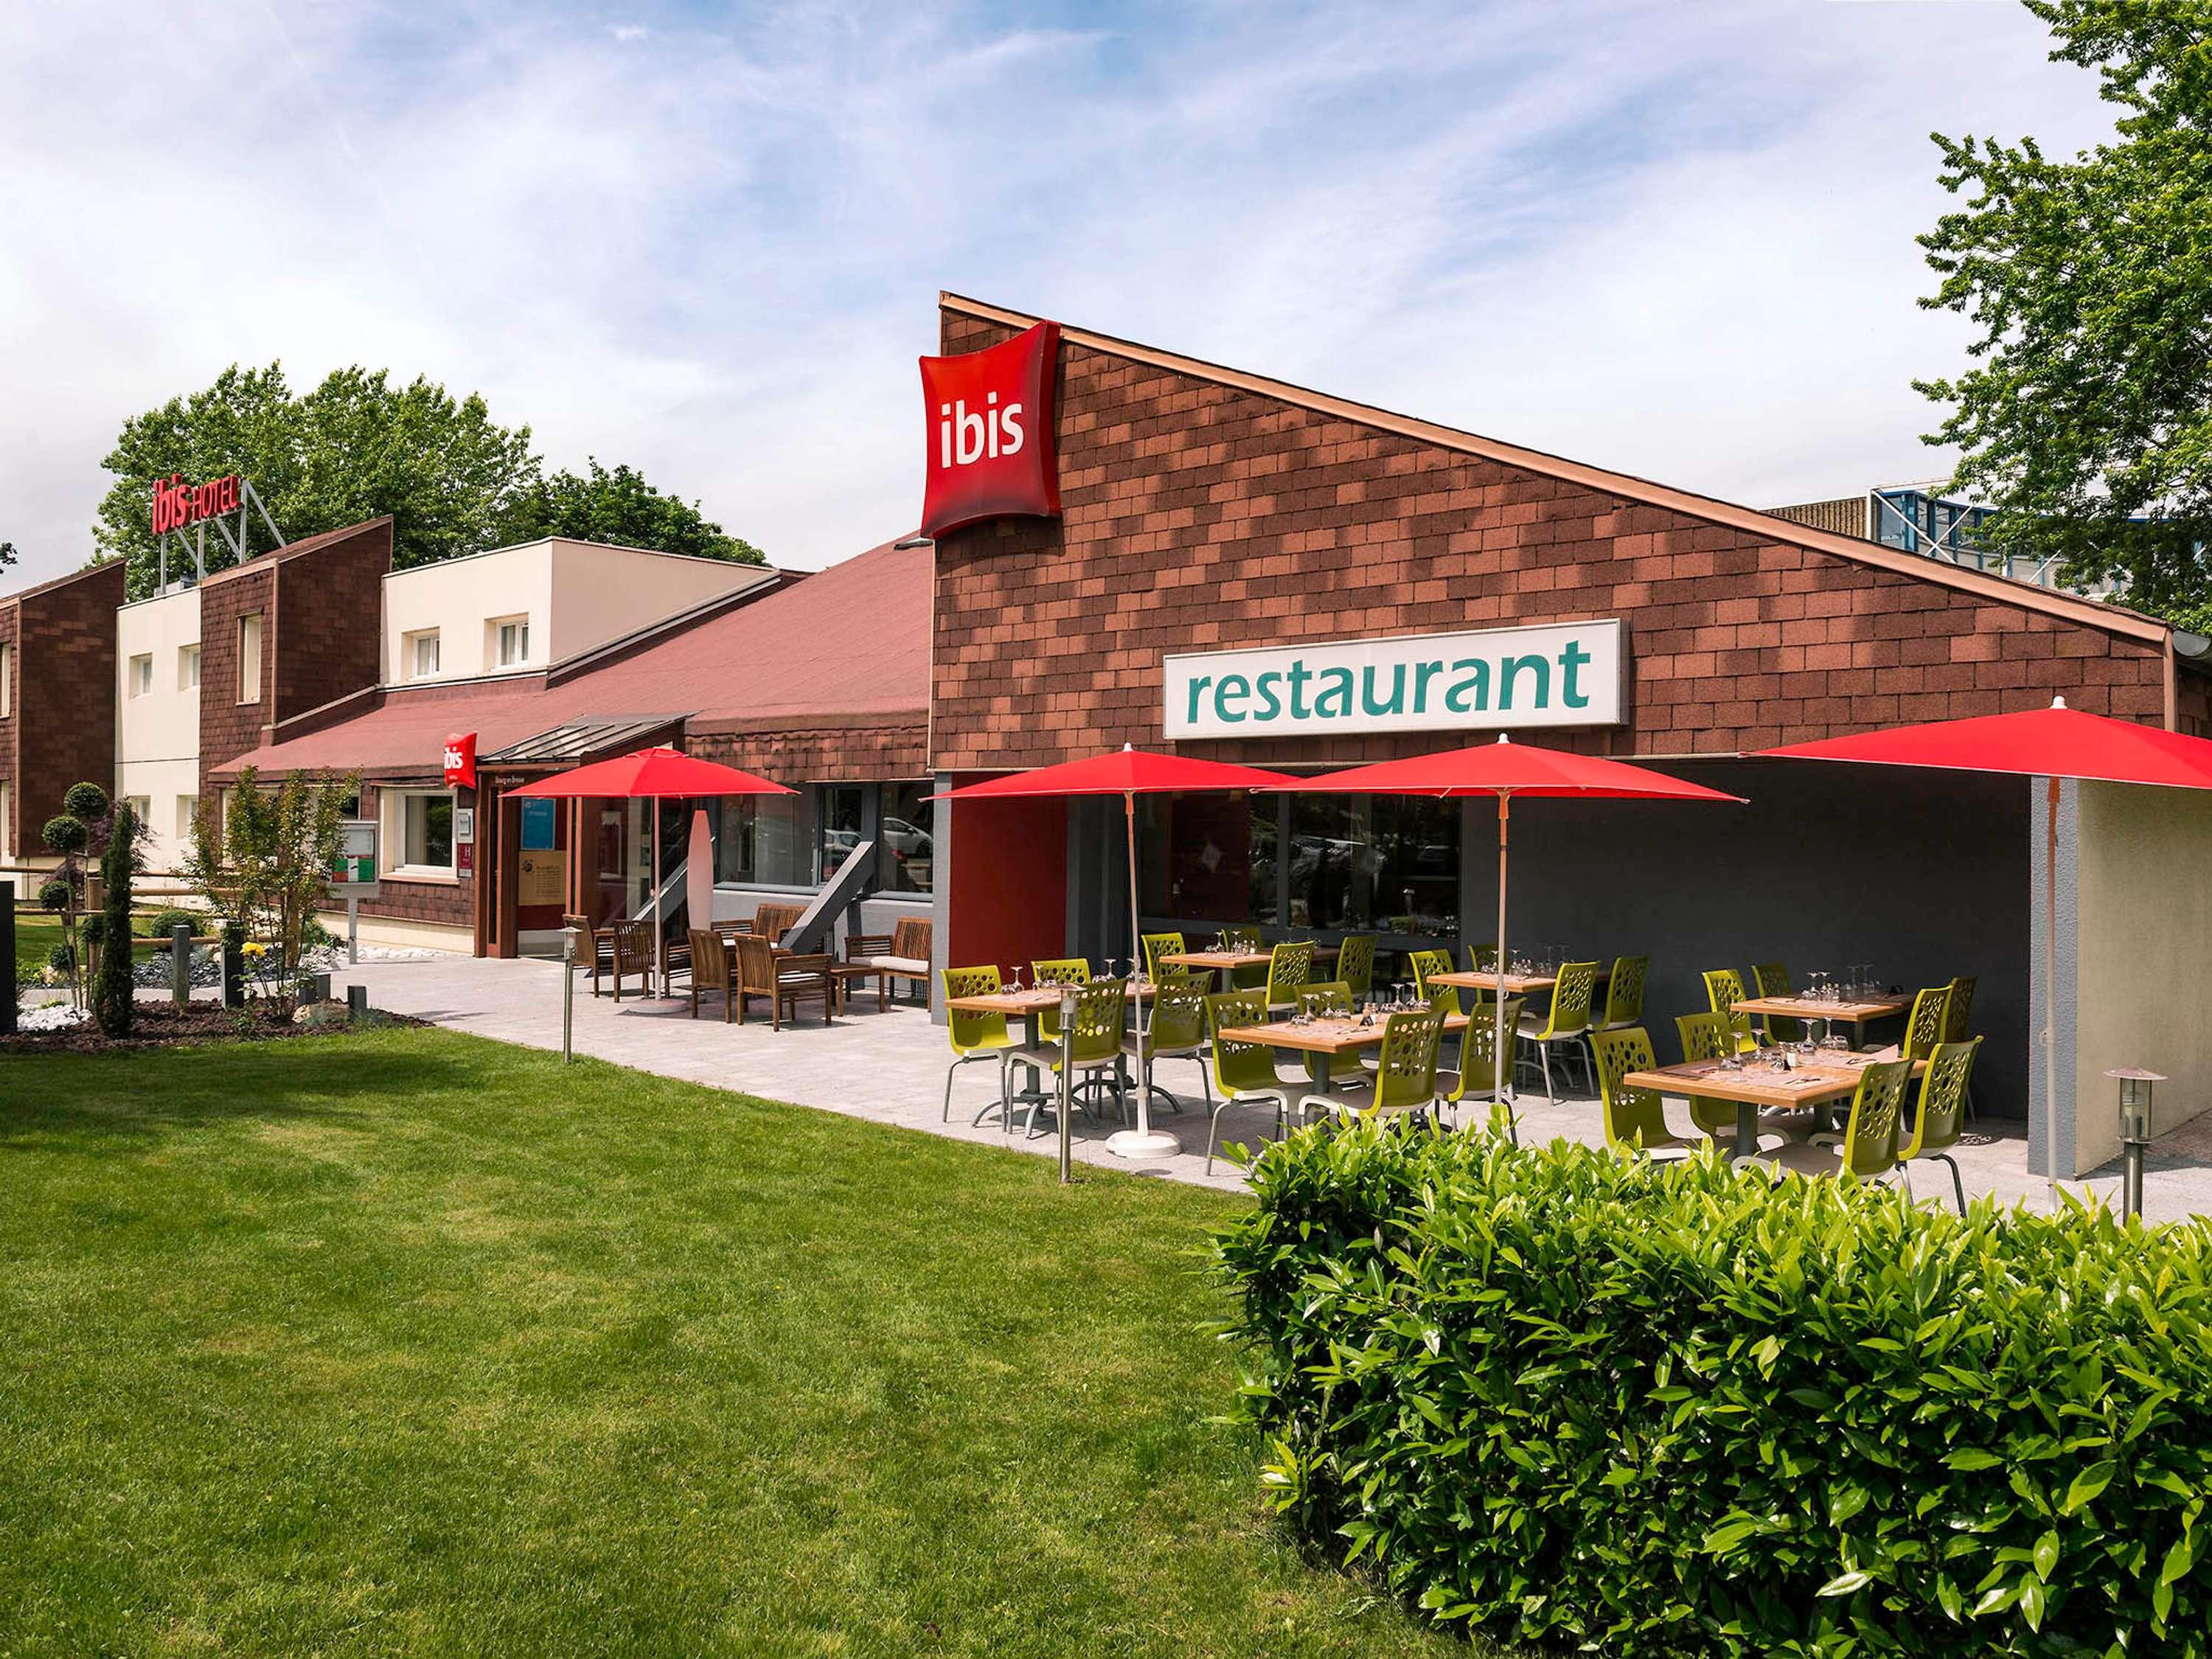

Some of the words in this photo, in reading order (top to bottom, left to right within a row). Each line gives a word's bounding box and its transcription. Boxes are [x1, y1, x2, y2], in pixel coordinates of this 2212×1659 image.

[942, 391, 1024, 468] ibis
[152, 473, 192, 535] ibis
[192, 475, 242, 521] HOTEL
[1186, 639, 1592, 723] restaurant
[444, 746, 463, 769] ibis
